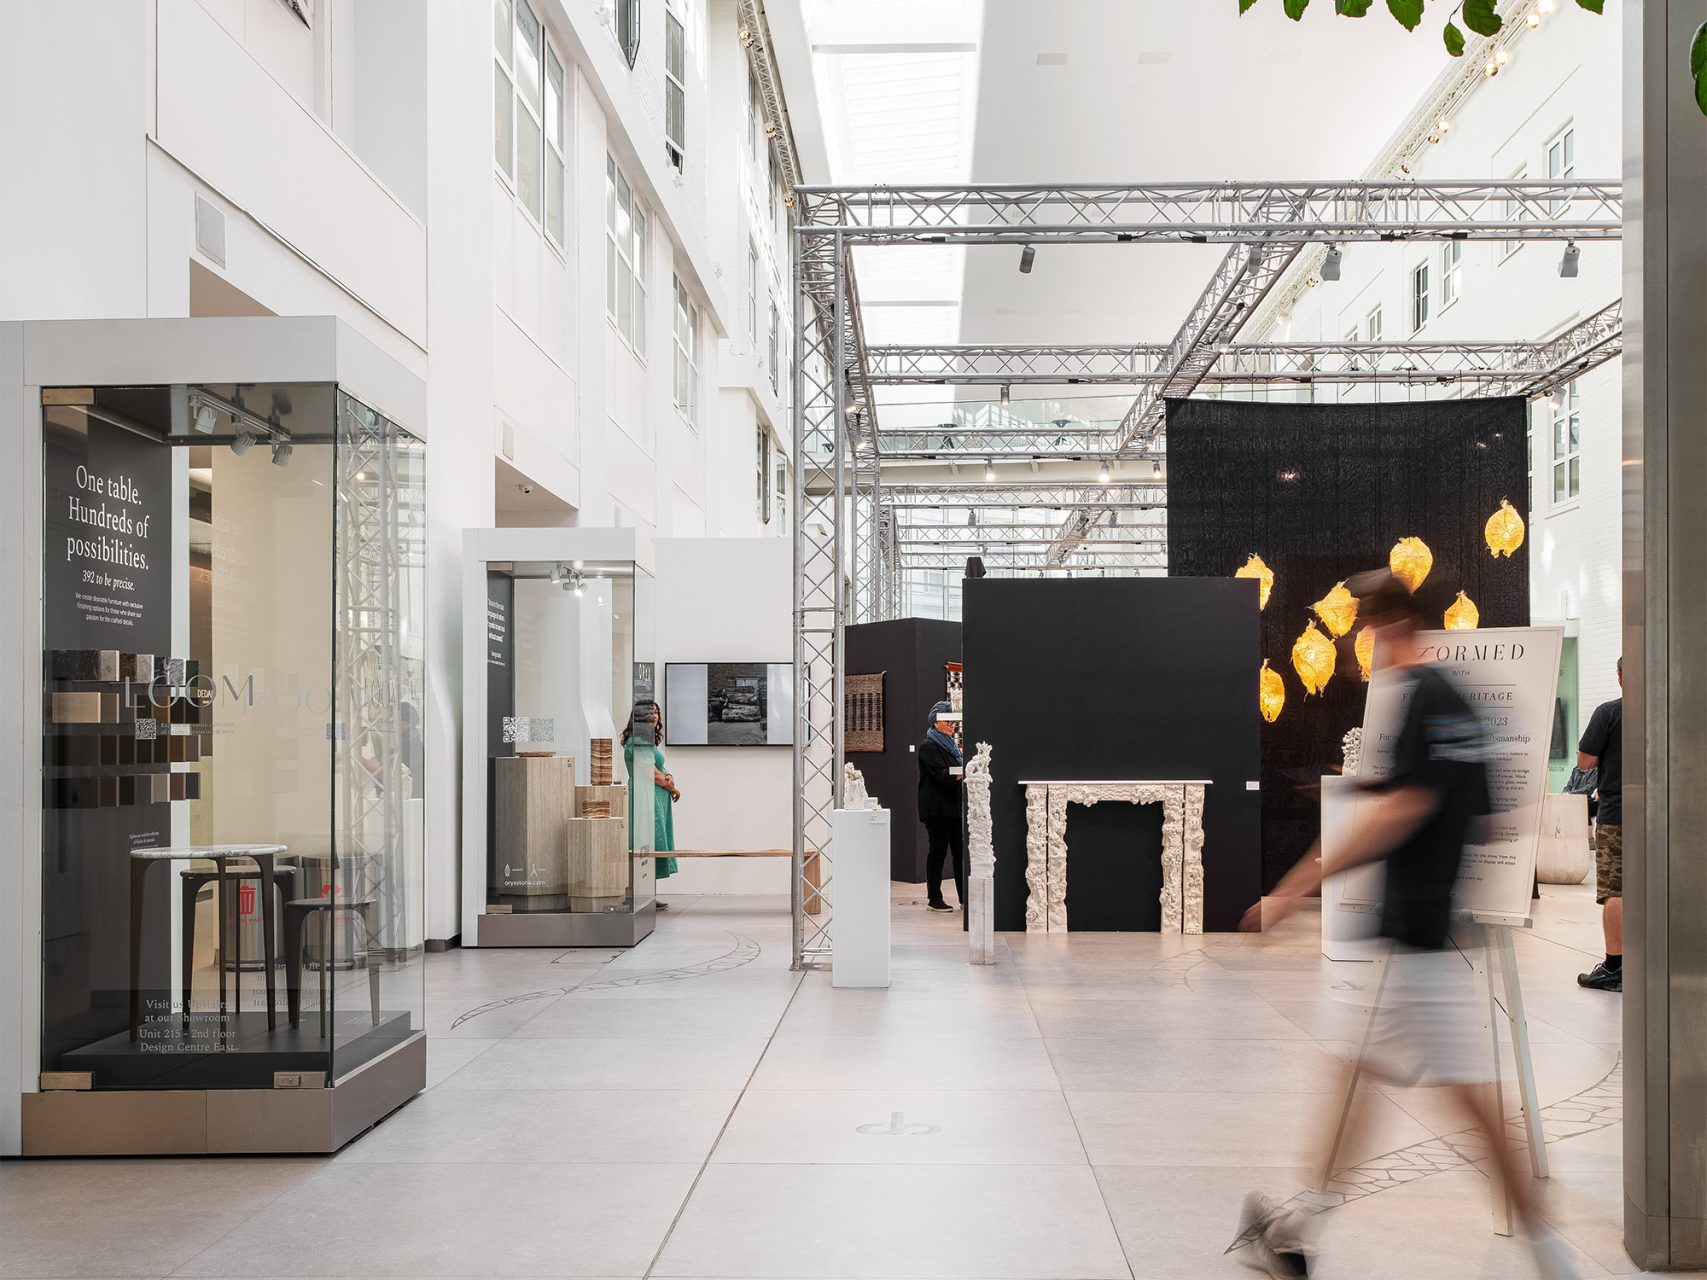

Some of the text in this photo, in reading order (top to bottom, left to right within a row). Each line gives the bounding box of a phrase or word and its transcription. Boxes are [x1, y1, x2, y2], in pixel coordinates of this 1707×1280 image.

[76, 465, 142, 505] One table.
[68, 495, 150, 539] Hundreds of
[66, 535, 149, 570] possibilities.
[82, 569, 135, 591] 392 to be precise.
[125, 674, 253, 708] LOOM
[1456, 692, 1513, 702] ERITAGE
[1484, 717, 1508, 727] 2023
[1379, 732, 1391, 740] For
[1485, 733, 1531, 744] ftsmanship
[146, 1000, 170, 1009] Visit
[173, 1001, 183, 1009] us
[139, 1028, 161, 1038] Unit
[164, 1029, 181, 1038] 215
[191, 1028, 209, 1038] 2nd
[212, 1028, 236, 1038] floor
[140, 1042, 174, 1054] Design
[177, 1042, 210, 1052] Centre
